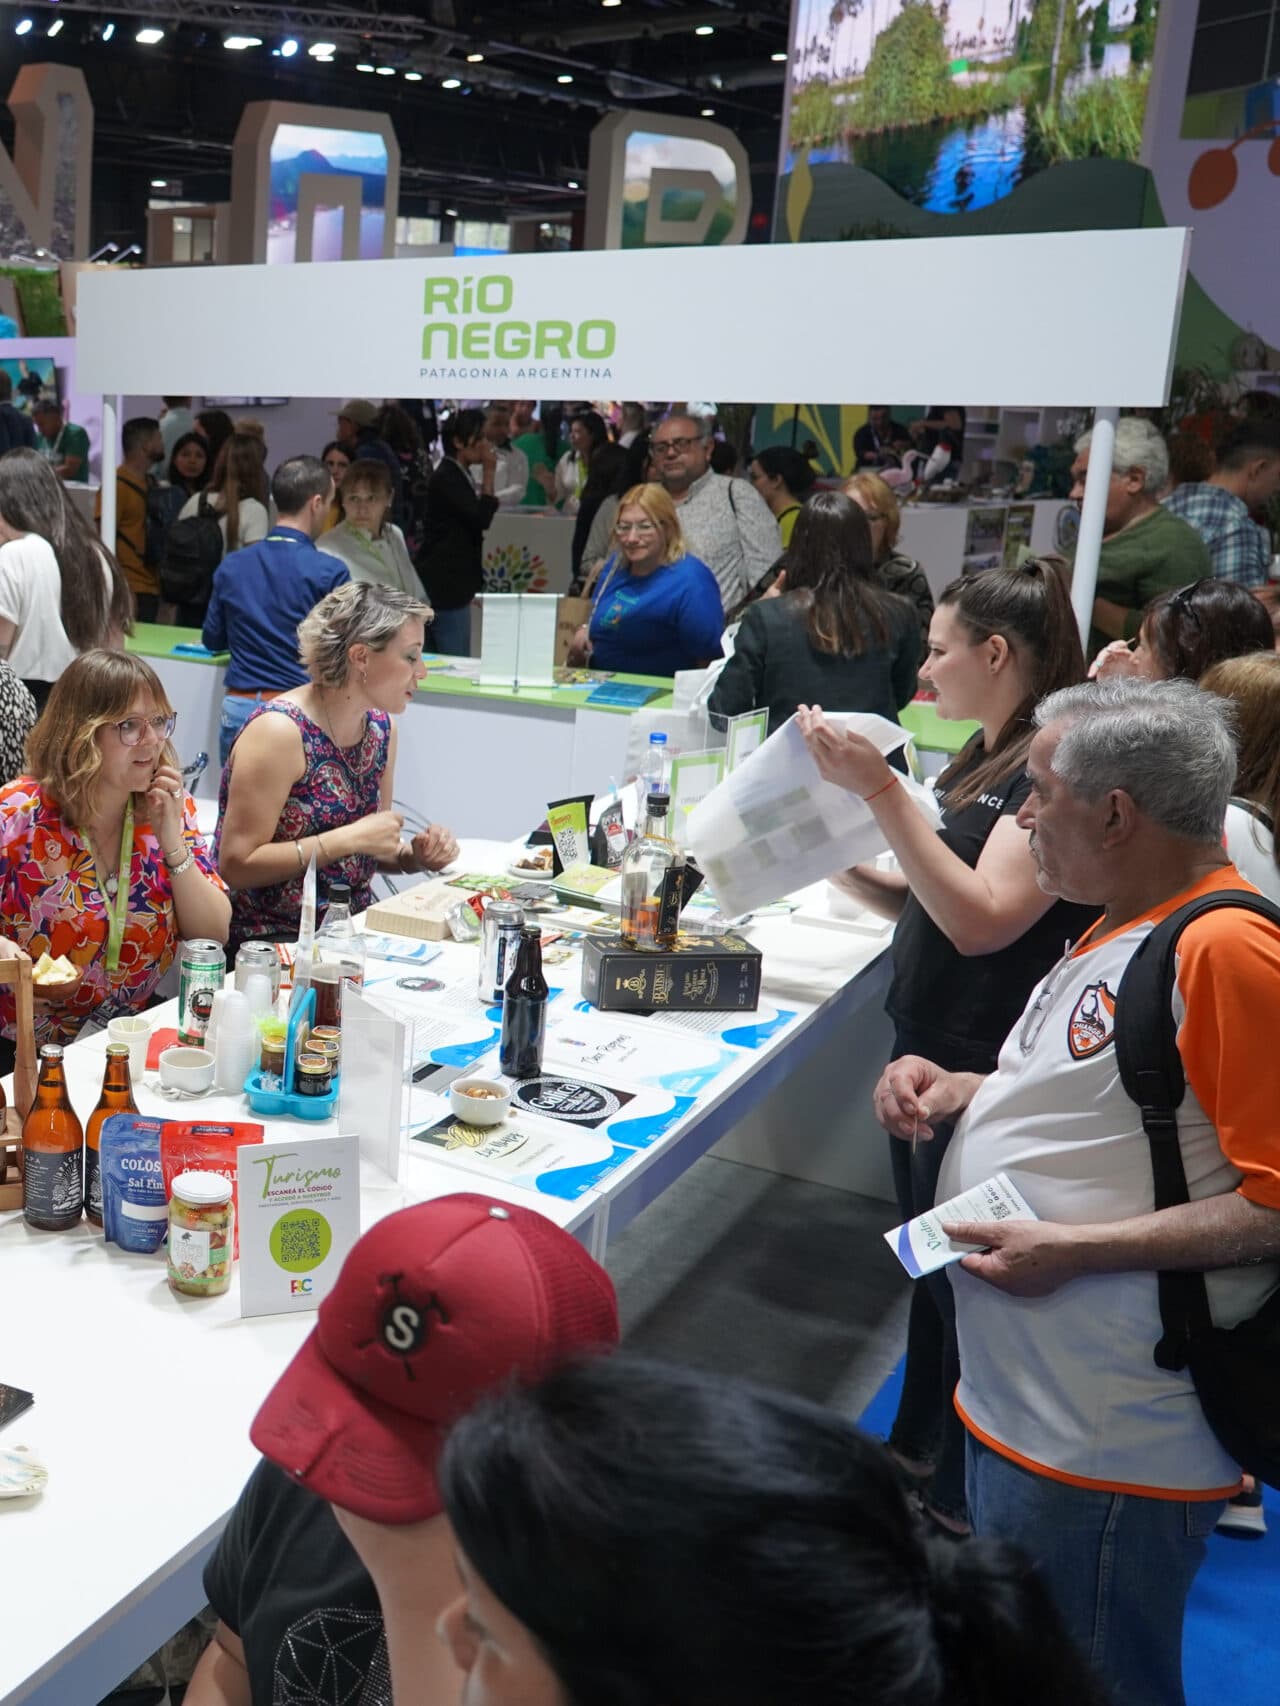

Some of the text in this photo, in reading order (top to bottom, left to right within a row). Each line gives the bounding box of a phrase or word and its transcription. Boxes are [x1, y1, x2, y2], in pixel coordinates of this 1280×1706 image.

[421, 320, 616, 360] NEGRO
[420, 367, 613, 379] PATAGONIA ARGENTINA
[121, 1158, 161, 1172] COLOS
[252, 1153, 342, 1199] Turismo
[147, 1179, 164, 1190] Fin
[291, 1278, 313, 1294] RC
